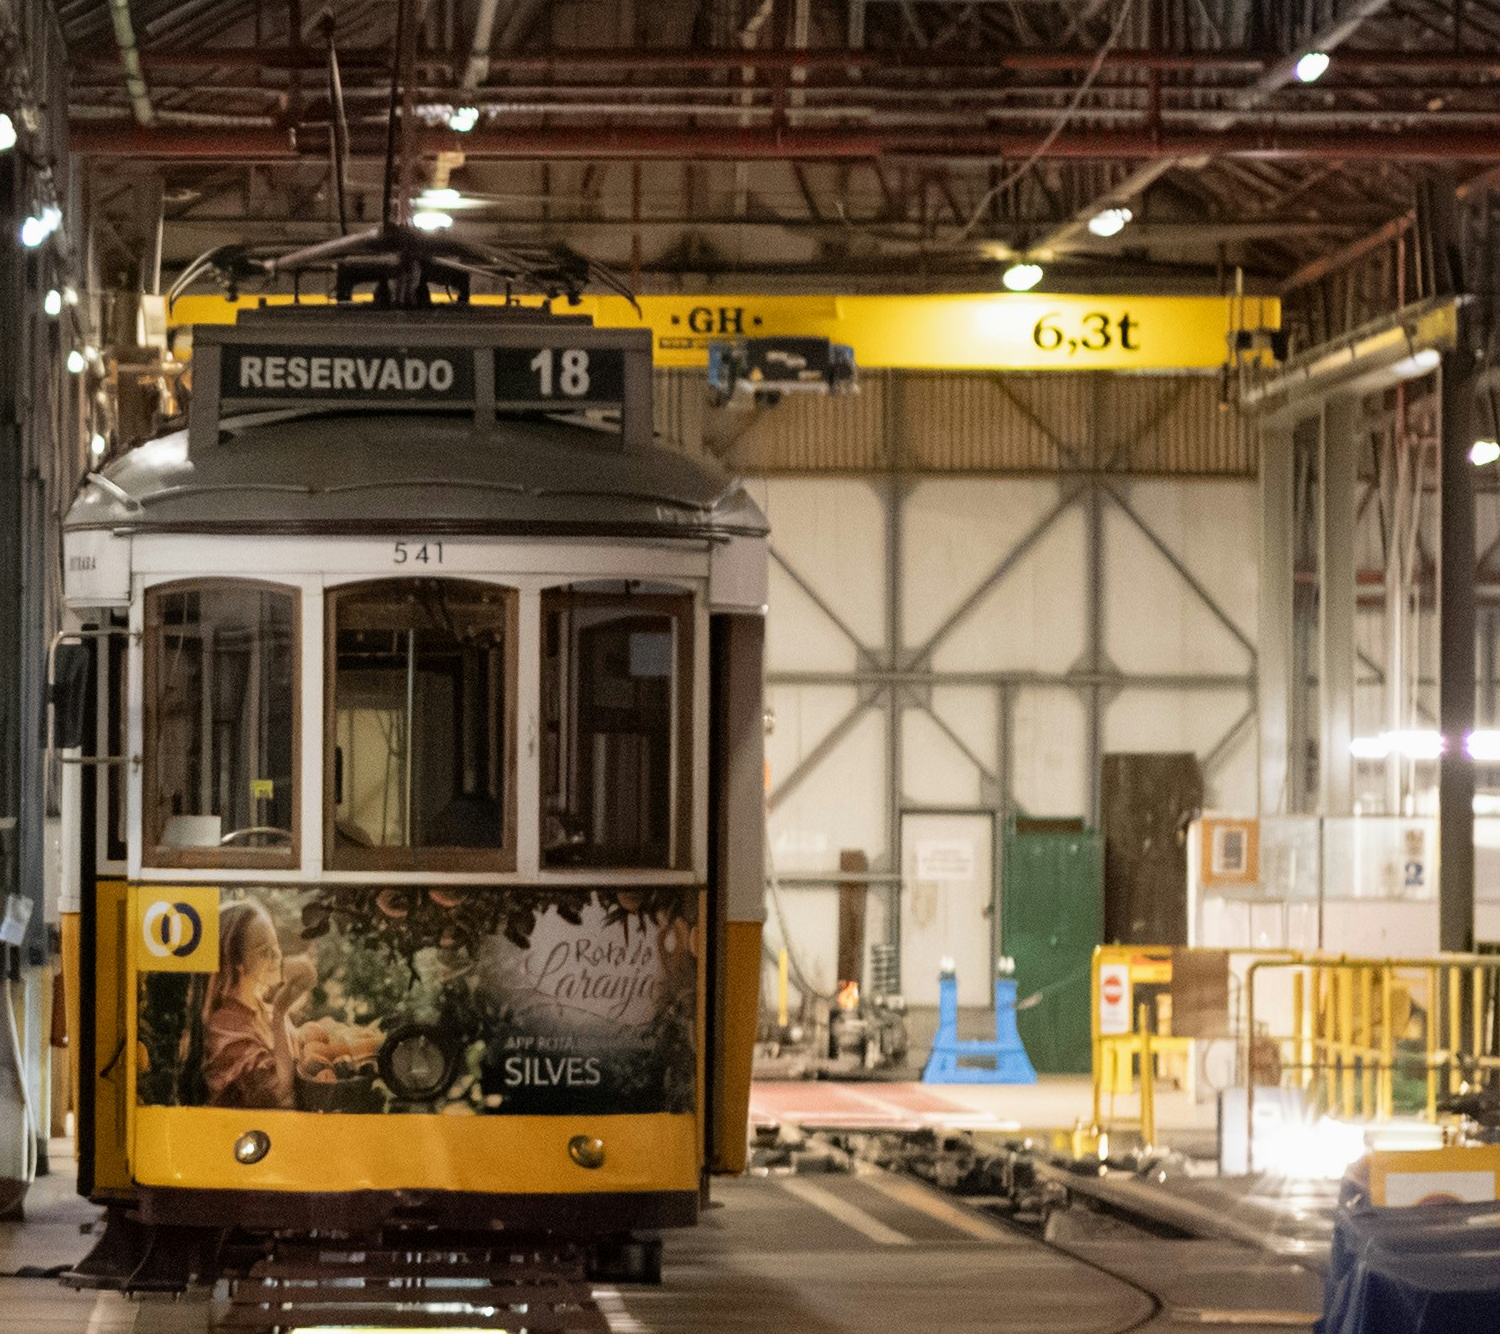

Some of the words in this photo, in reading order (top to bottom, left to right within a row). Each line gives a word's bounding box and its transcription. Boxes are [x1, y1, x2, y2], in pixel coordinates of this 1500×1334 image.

[687, 306, 744, 334] GH
[1032, 310, 1141, 354] 6,3t
[239, 355, 455, 392] RESERVADO
[529, 348, 591, 397] 18
[393, 542, 443, 564] 541
[524, 941, 656, 1018] Laranja
[504, 1056, 601, 1086] SILVES
